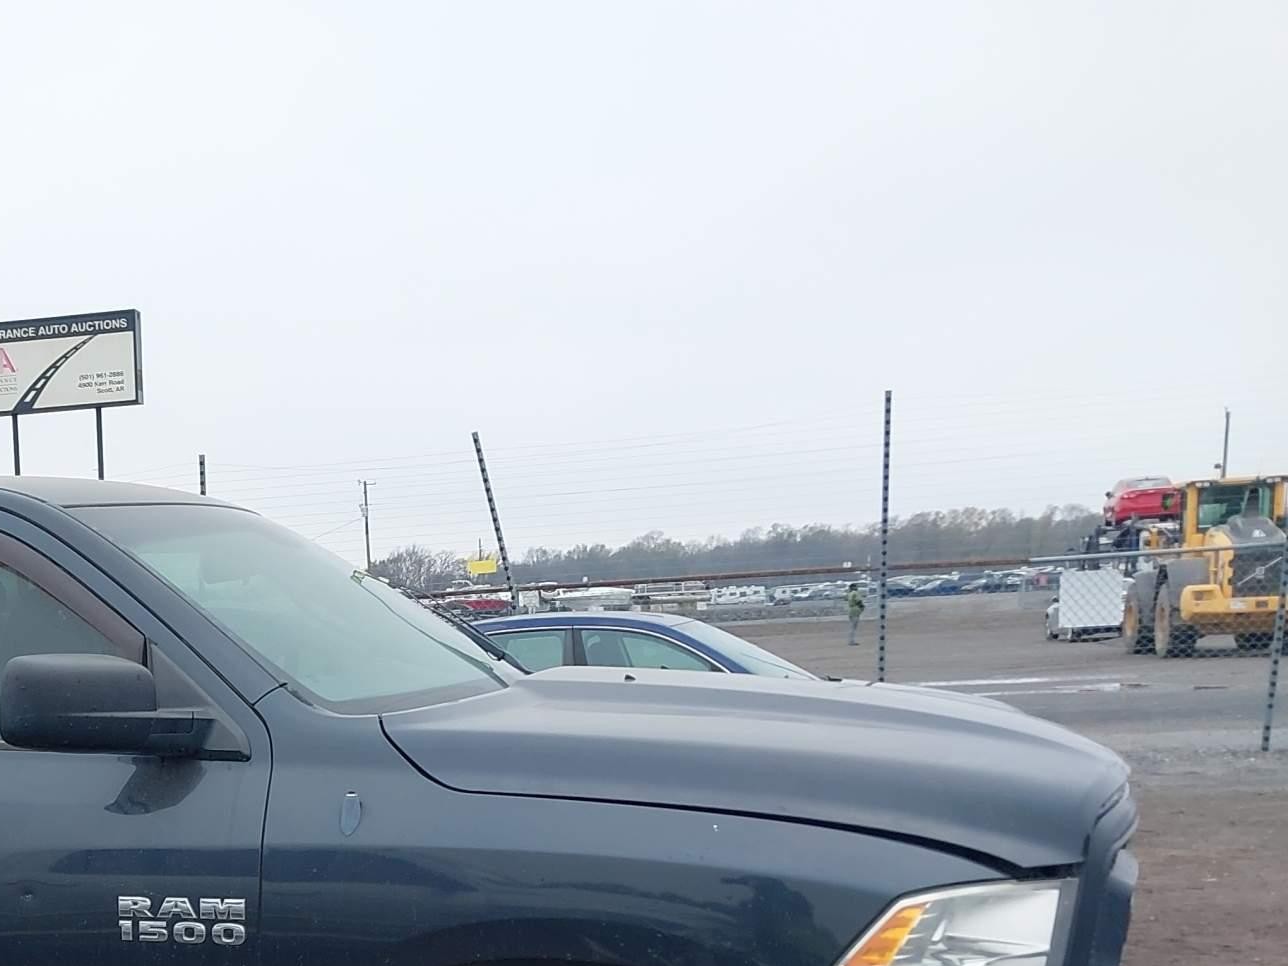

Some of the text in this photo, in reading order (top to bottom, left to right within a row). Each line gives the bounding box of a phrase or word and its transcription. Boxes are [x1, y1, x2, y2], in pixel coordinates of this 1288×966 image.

[38, 324, 68, 336] AUTO
[71, 318, 128, 332] AUCTIONS
[118, 895, 246, 920] RAM
[118, 920, 246, 945] 1500
